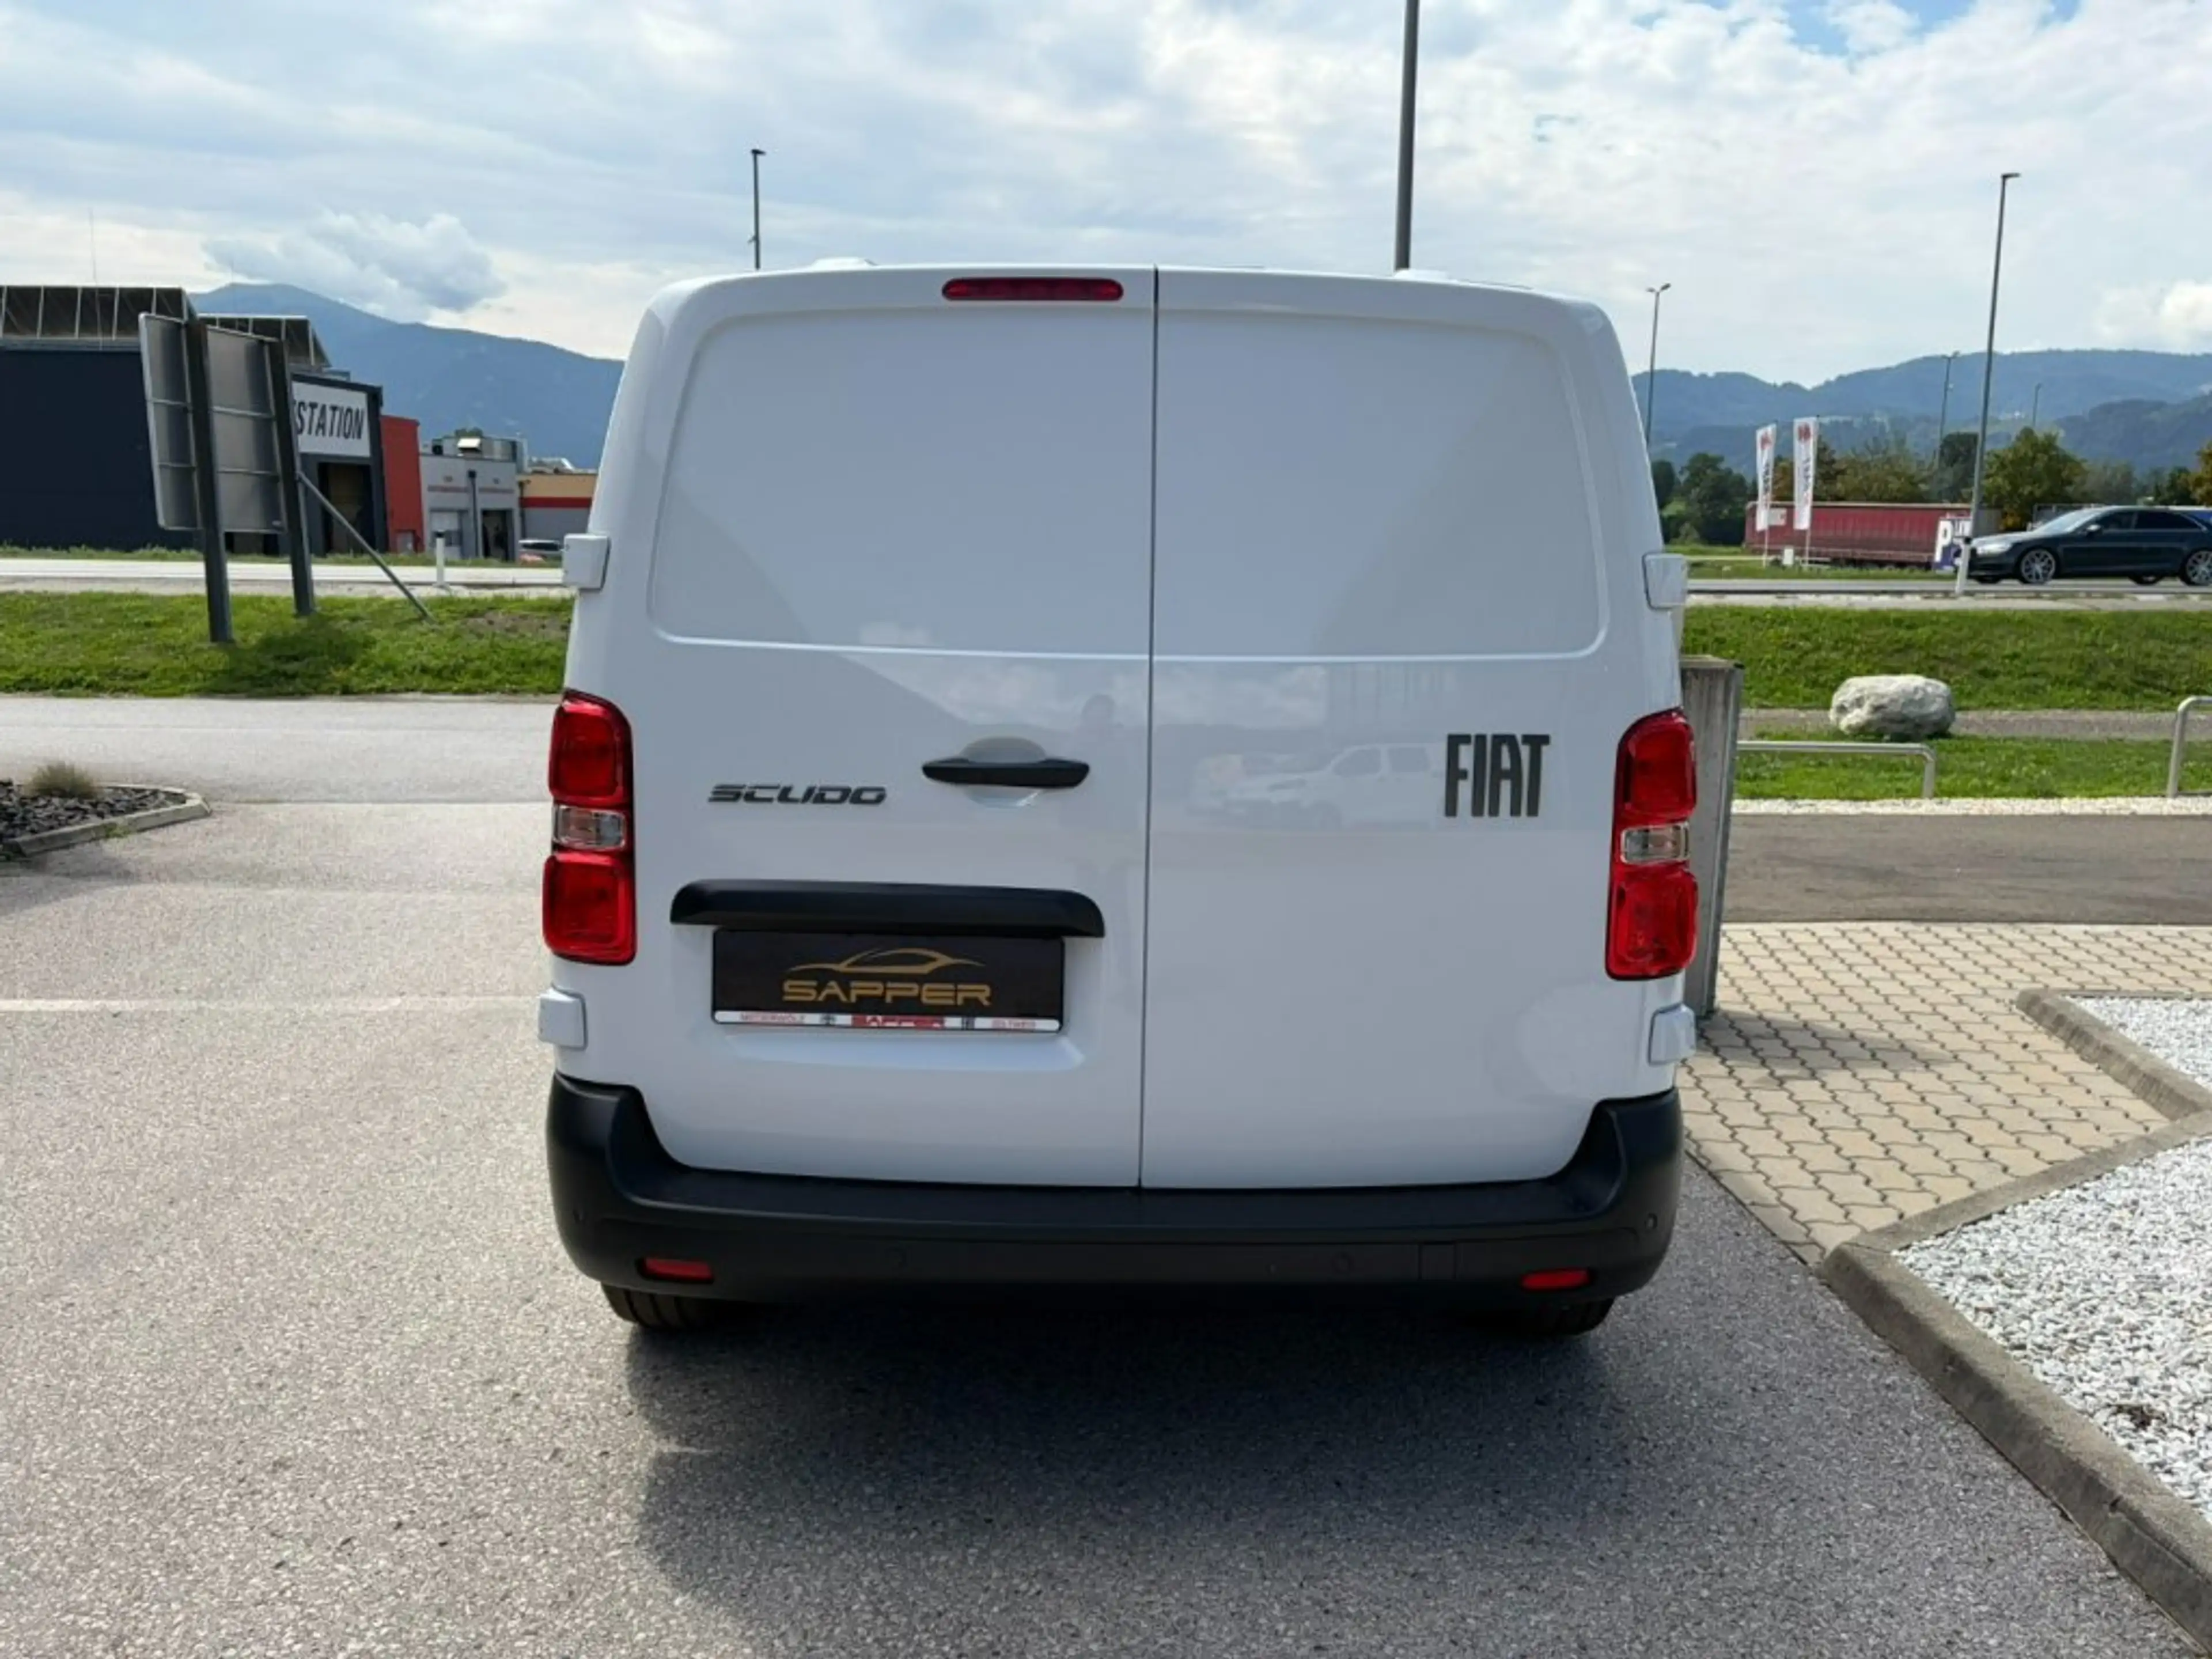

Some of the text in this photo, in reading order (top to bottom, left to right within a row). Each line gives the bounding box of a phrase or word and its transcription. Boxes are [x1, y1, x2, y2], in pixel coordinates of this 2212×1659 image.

[293, 399, 365, 440] STATION
[1445, 734, 1551, 817] FIAT
[708, 783, 887, 805] SCUDO
[782, 980, 991, 1006] SAPPER
